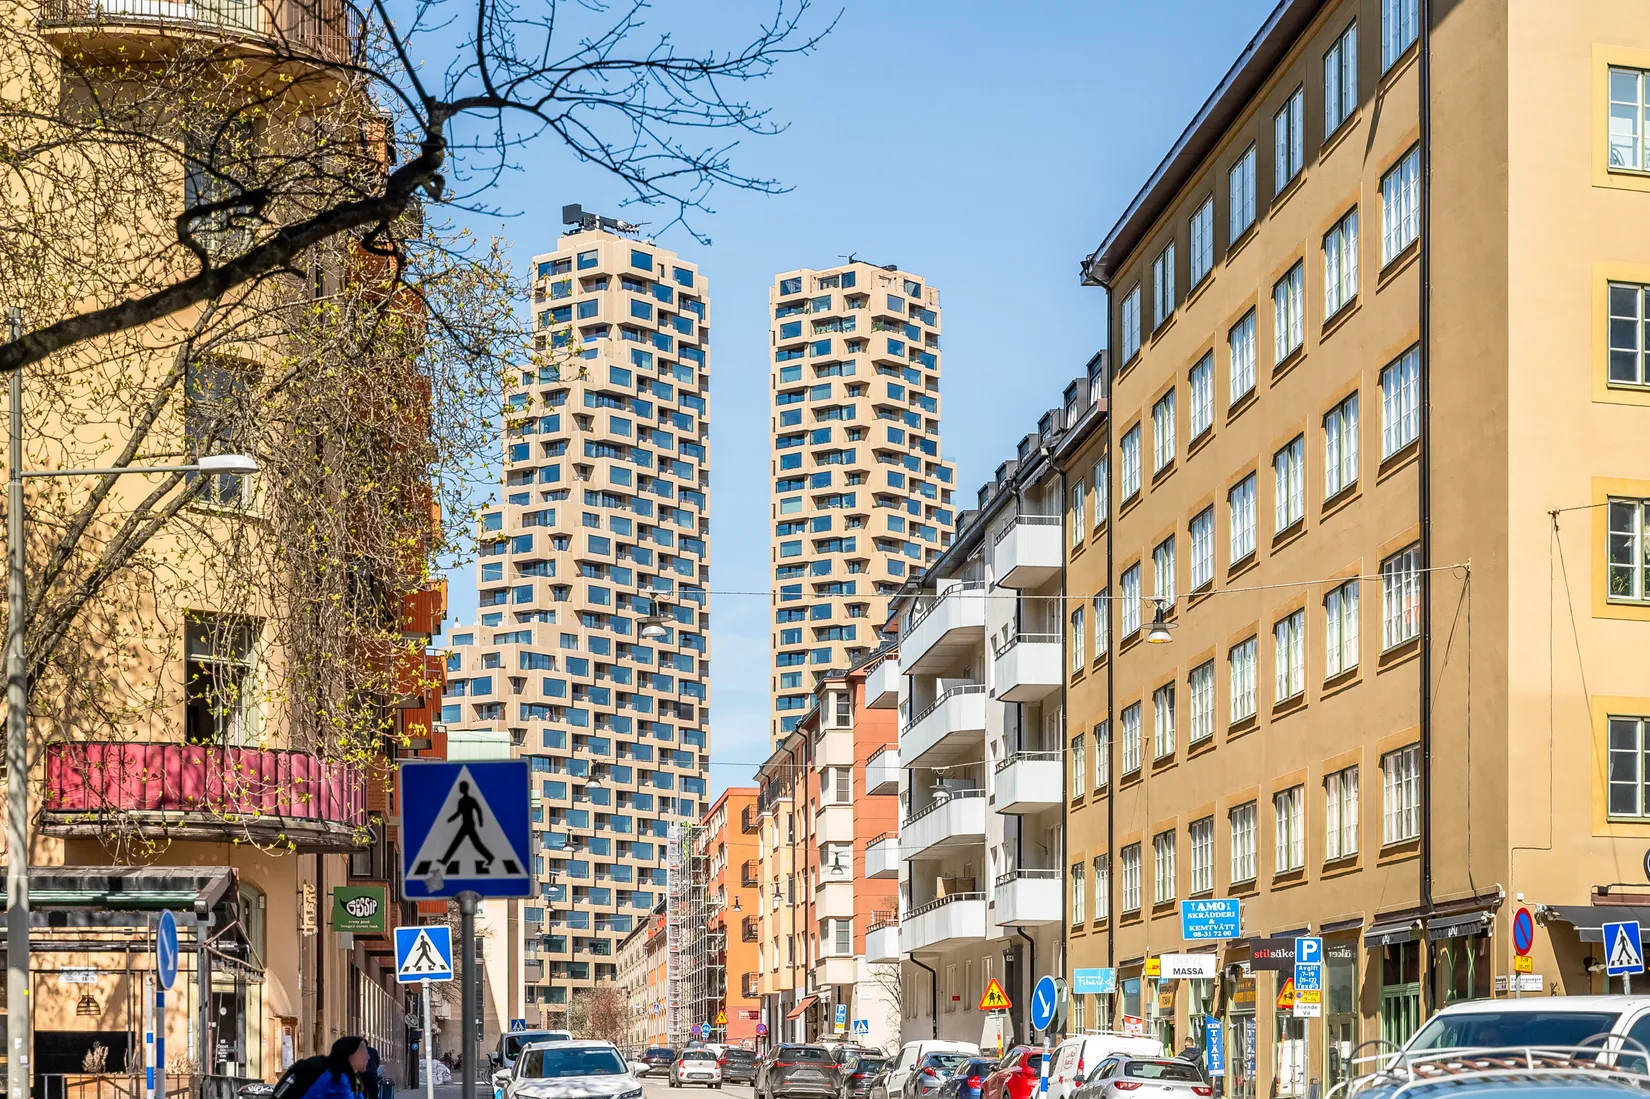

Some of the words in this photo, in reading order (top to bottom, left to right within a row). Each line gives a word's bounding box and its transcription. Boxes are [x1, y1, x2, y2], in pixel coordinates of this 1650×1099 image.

[1197, 902, 1226, 911] AMO
[1189, 923, 1235, 931] KEMTVÄTT
[1254, 948, 1296, 958] stilsäke
[1302, 940, 1318, 961] P
[1173, 967, 1204, 975] MASSA
[1210, 1029, 1220, 1069] TVÄTT
